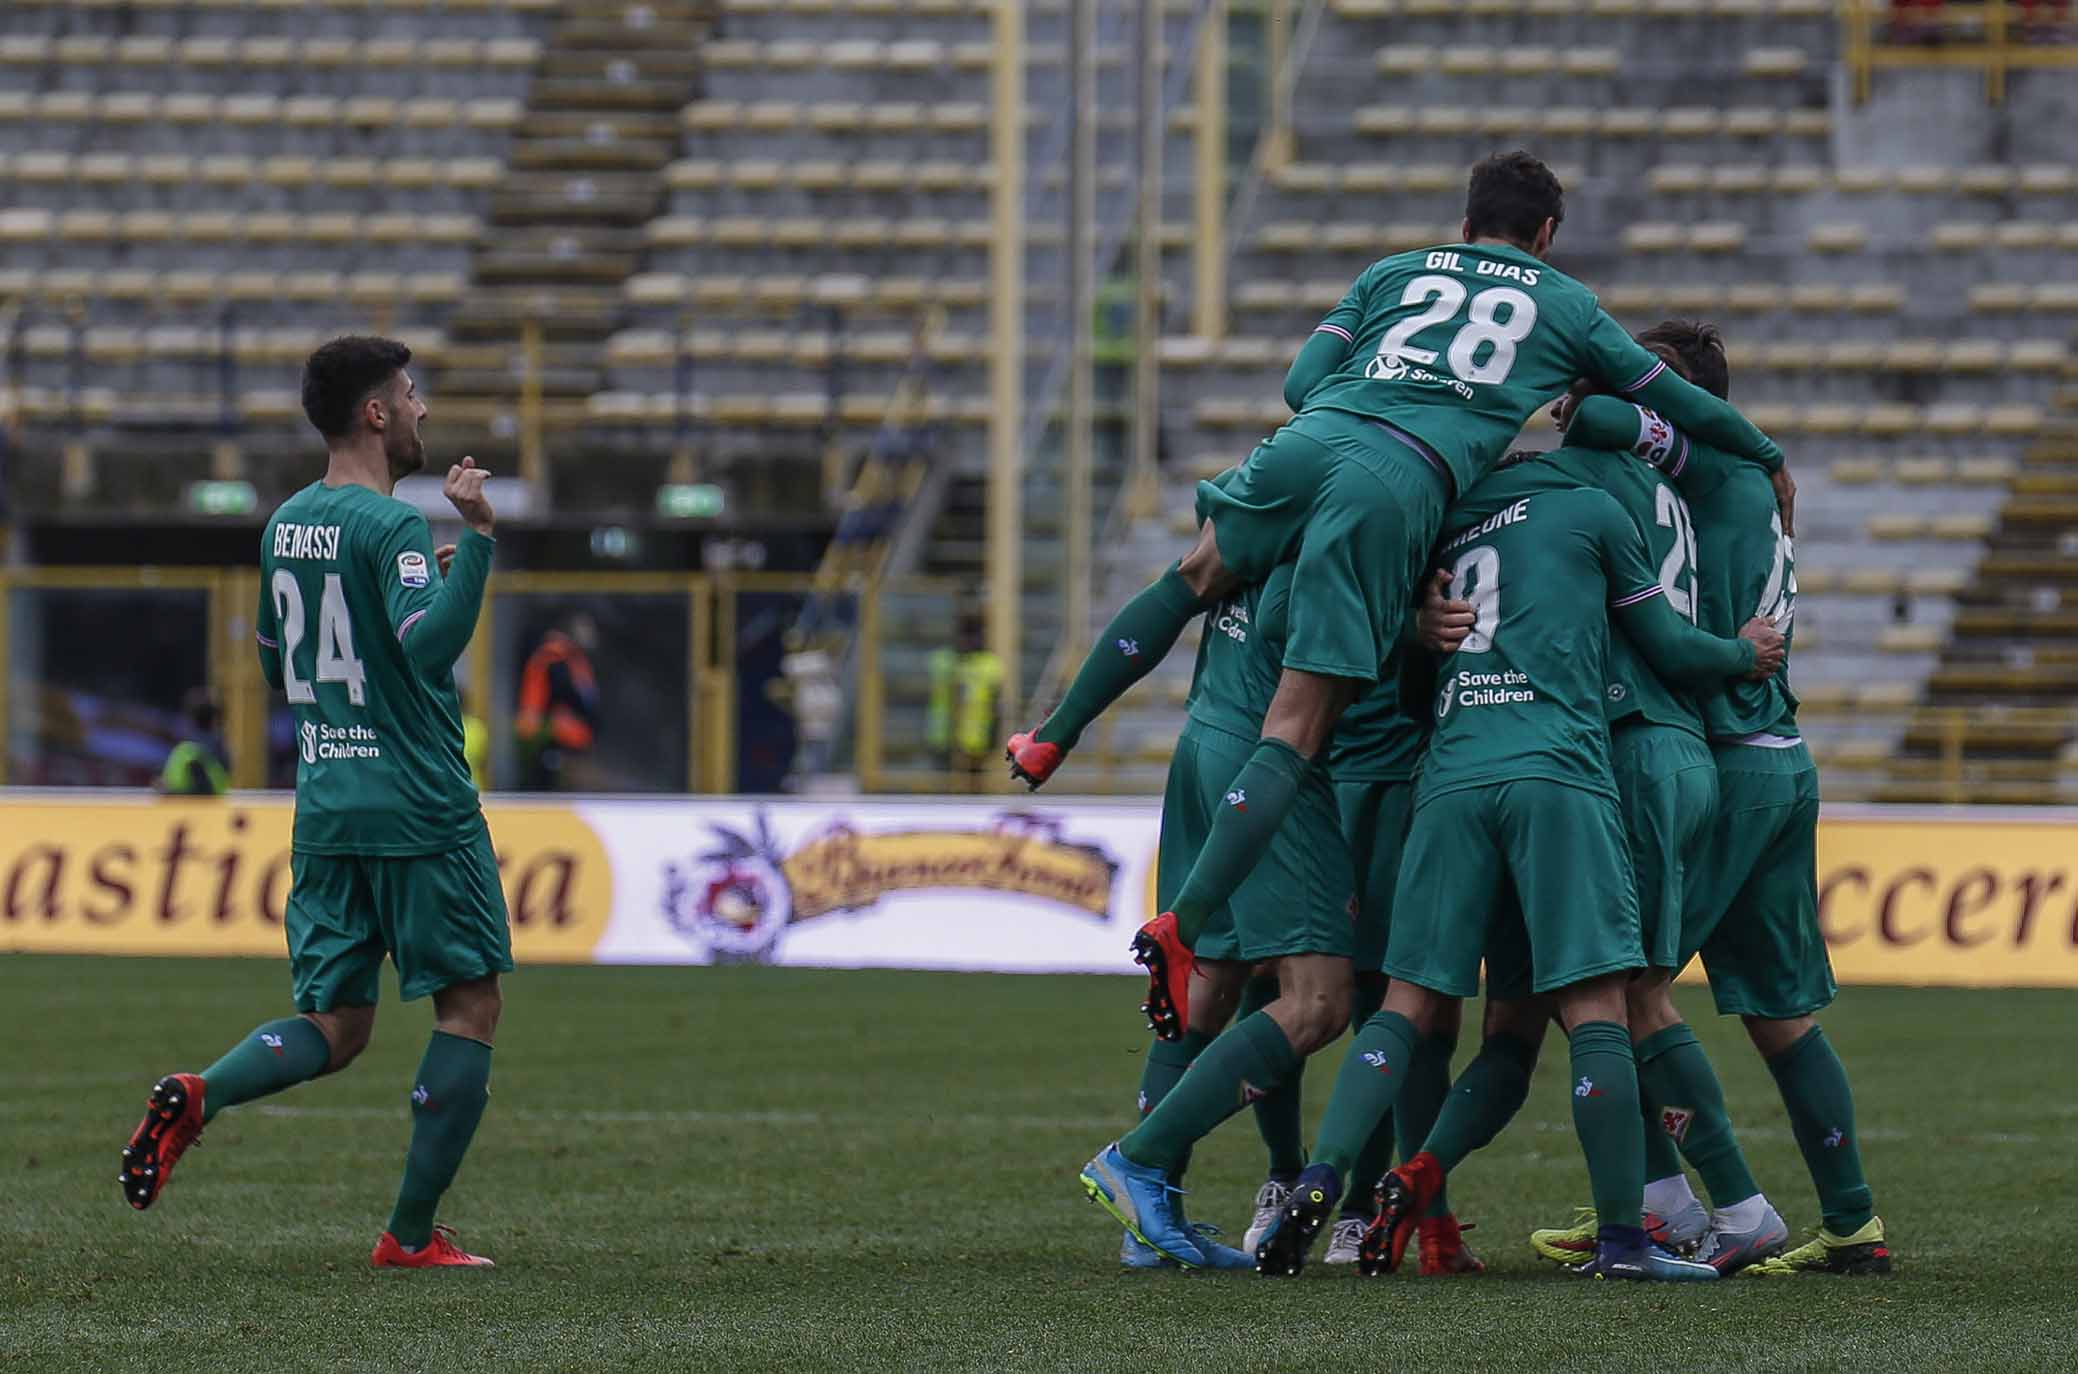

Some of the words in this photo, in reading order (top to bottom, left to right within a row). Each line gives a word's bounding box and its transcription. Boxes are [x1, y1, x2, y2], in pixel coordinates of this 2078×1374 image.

[1425, 252, 1465, 272] GIL
[1477, 260, 1541, 286] DIAS
[1377, 274, 1538, 385] 28
[274, 523, 340, 560] BENASSI
[272, 568, 367, 707] 24
[1458, 671, 1502, 687] Save
[1503, 669, 1528, 685] the
[1459, 688, 1534, 706] Children
[348, 724, 377, 740] the
